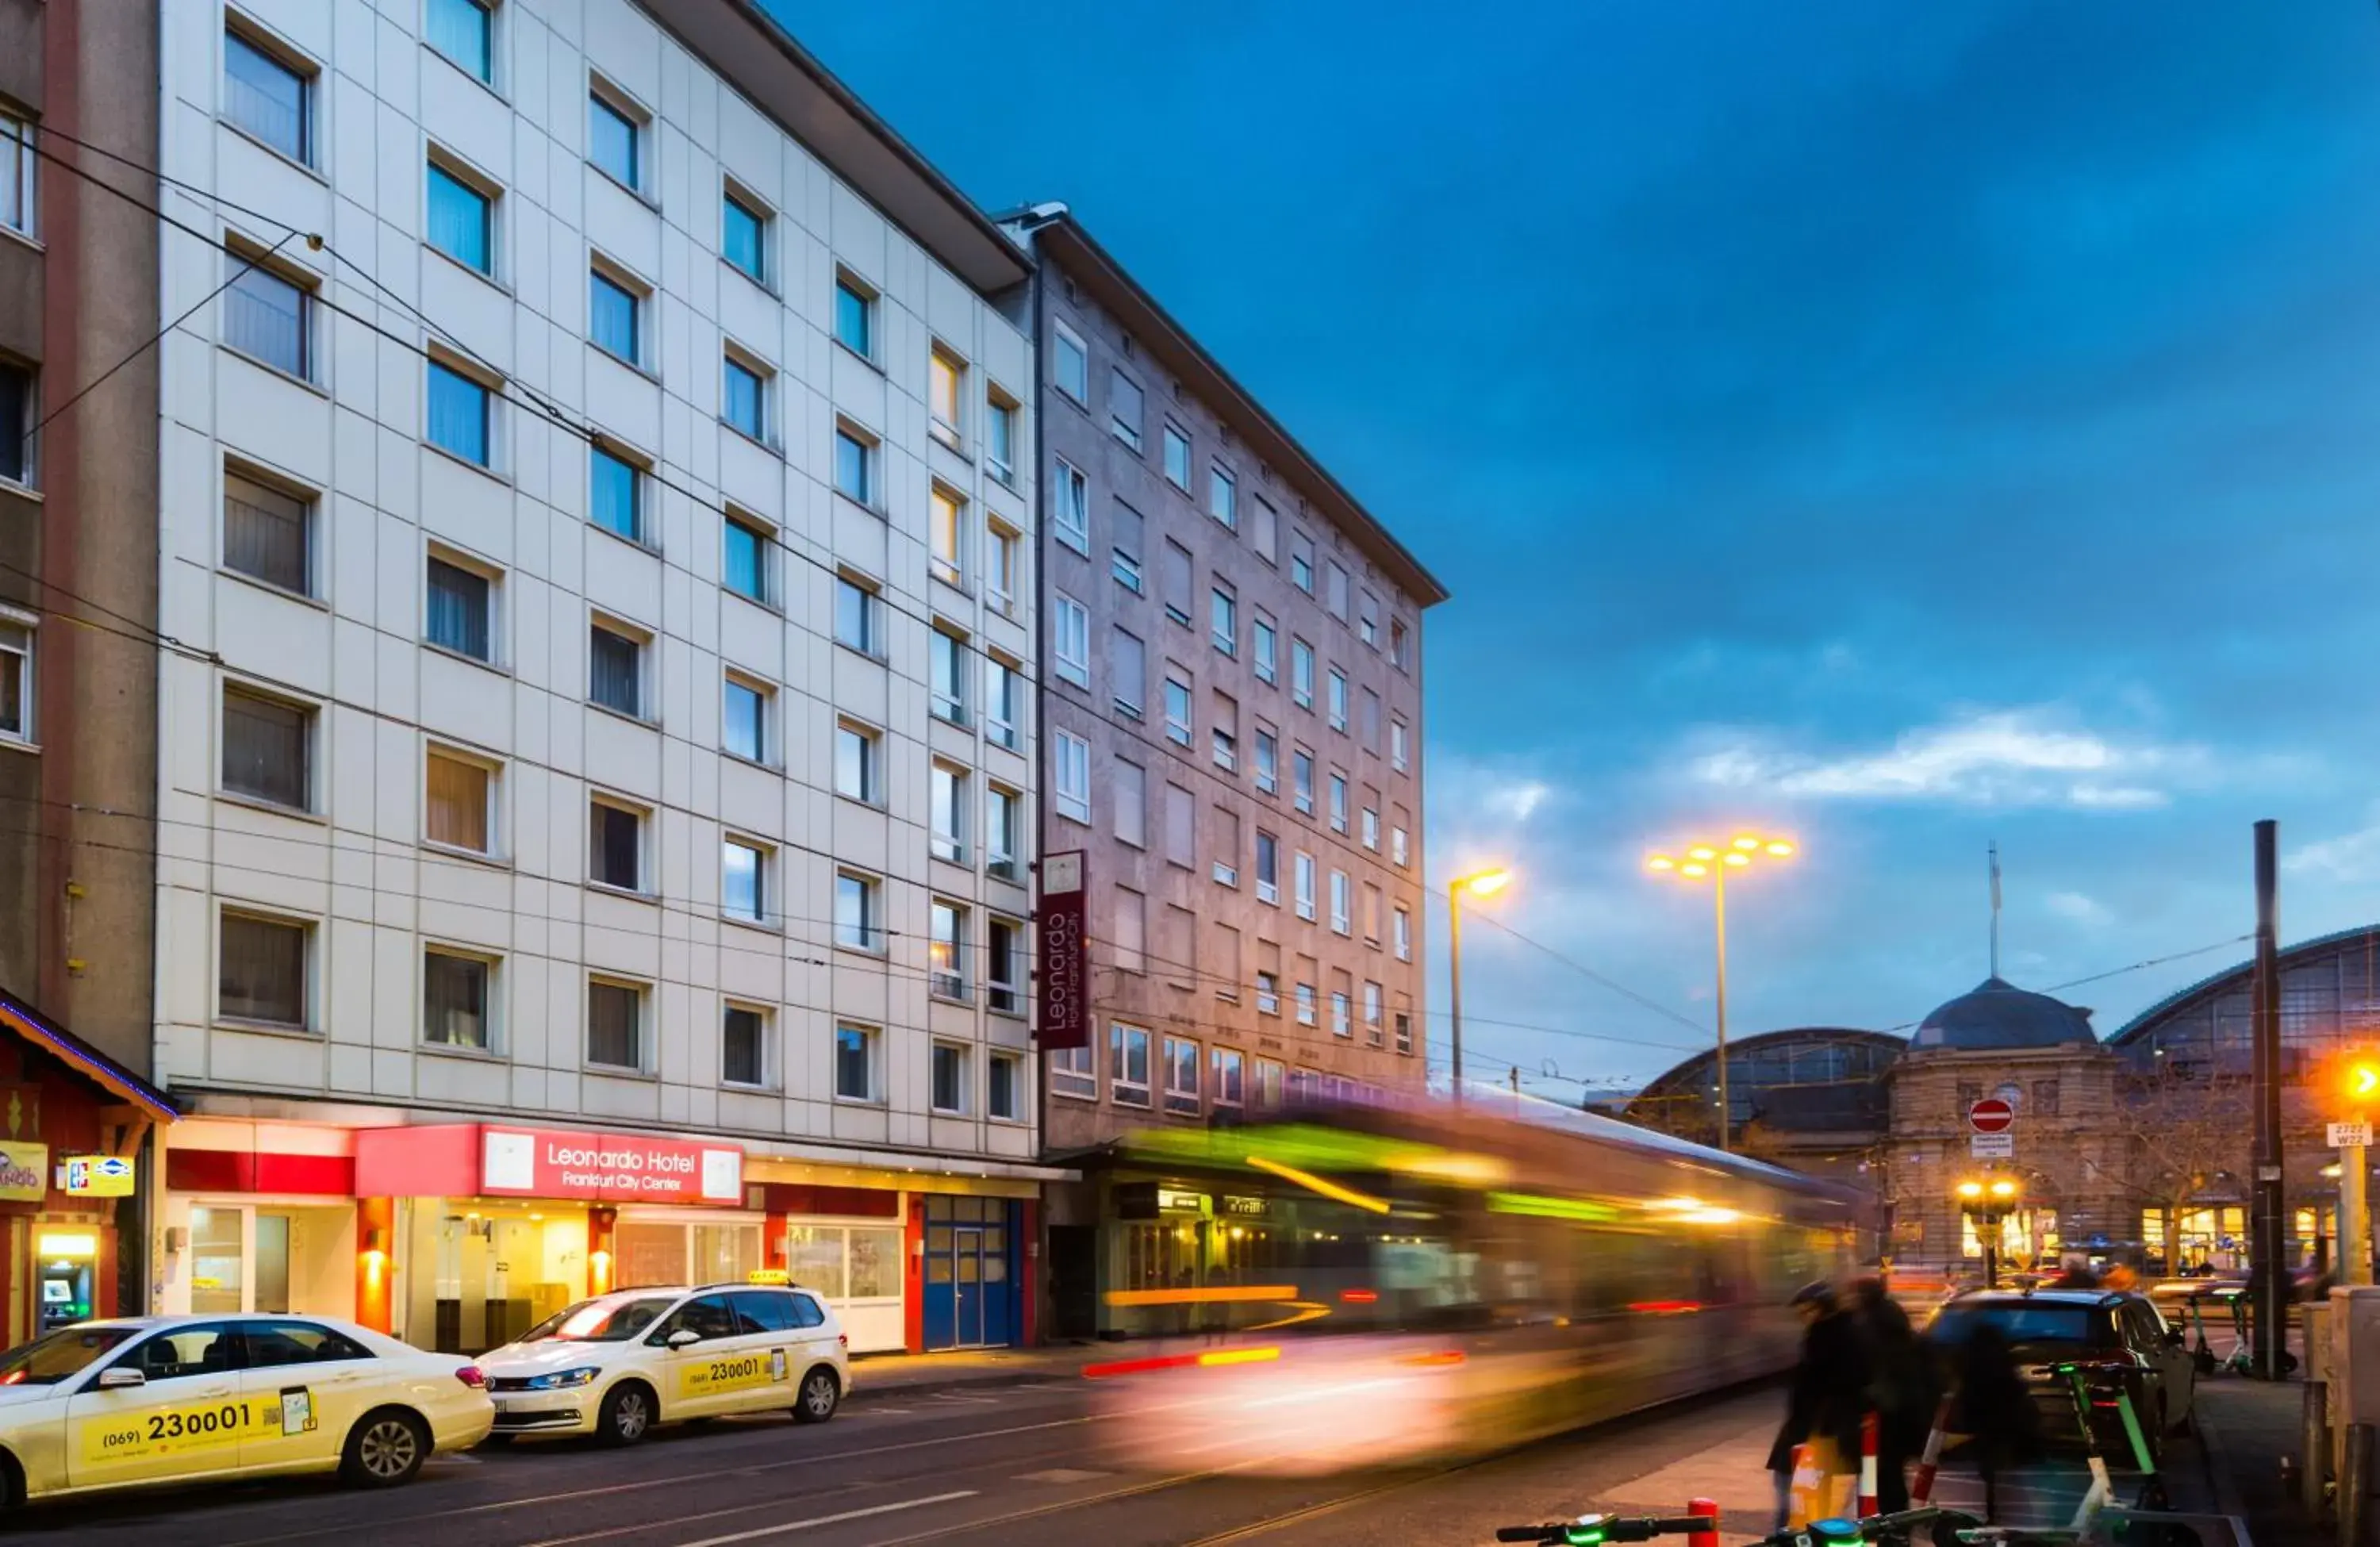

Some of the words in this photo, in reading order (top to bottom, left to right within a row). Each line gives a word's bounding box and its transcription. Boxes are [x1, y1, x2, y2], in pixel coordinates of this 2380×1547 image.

[1046, 913, 1065, 1031] Leonardo
[547, 1142, 643, 1170] Leonardo
[648, 1154, 695, 1173] Hotel
[562, 1171, 614, 1188] Frankfurt
[616, 1173, 639, 1190] City
[642, 1176, 681, 1191] Center
[711, 1357, 758, 1381] 230001
[103, 1430, 140, 1448] (069)
[148, 1403, 250, 1441] 230001
